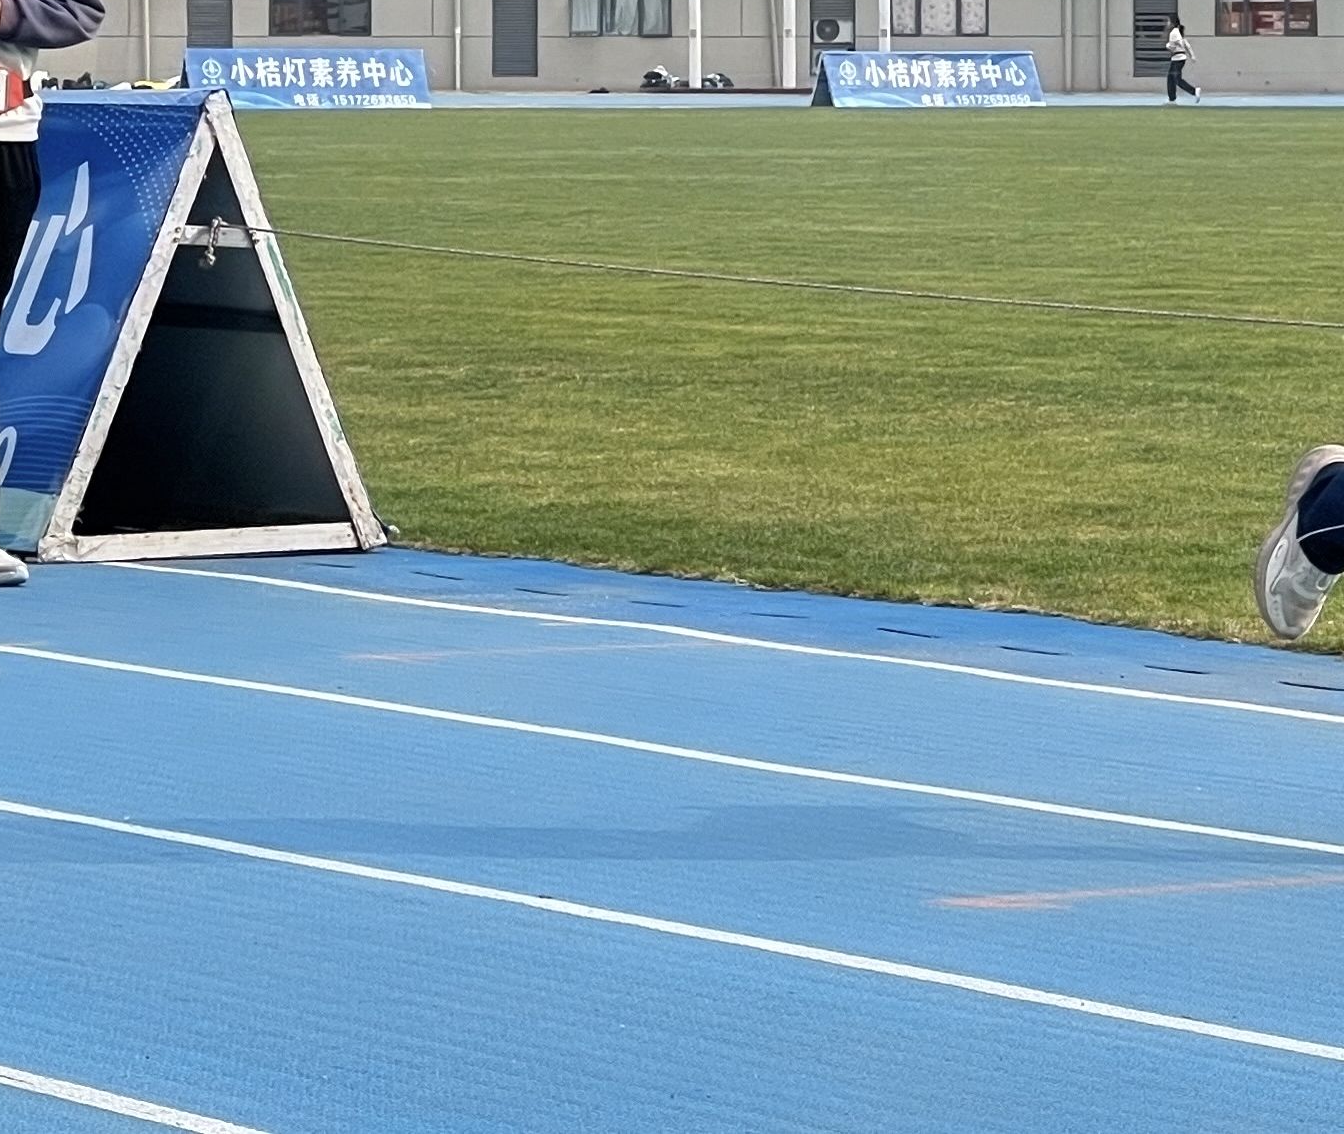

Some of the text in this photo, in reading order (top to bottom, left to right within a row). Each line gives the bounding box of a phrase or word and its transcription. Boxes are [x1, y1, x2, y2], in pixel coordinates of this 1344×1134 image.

[230, 57, 414, 88] 小桔灯素养中心
[865, 58, 1027, 88] 小桔灯素养中心
